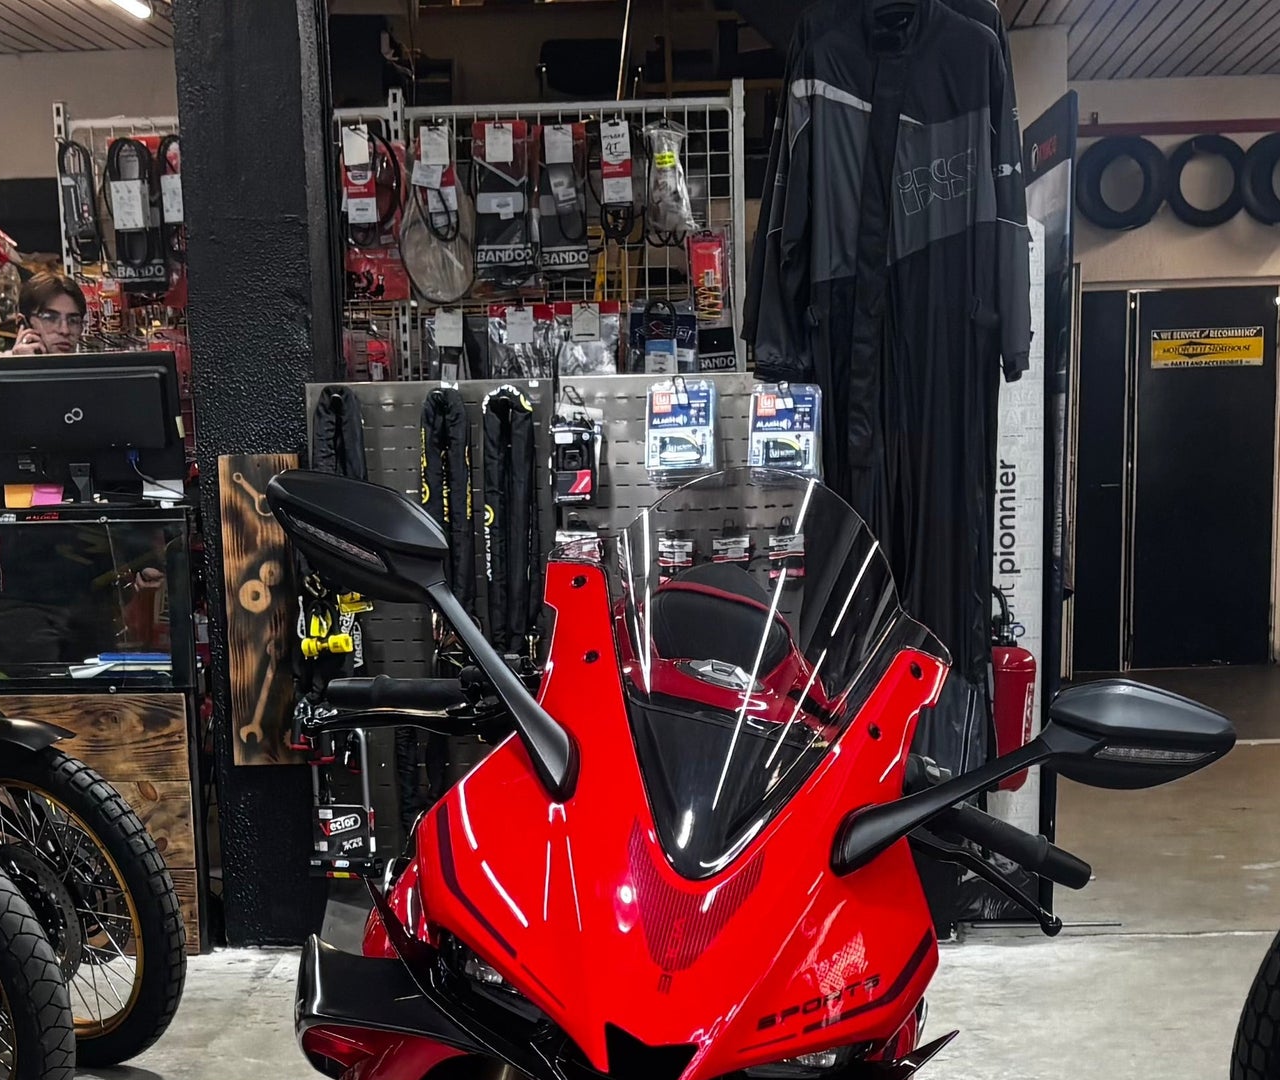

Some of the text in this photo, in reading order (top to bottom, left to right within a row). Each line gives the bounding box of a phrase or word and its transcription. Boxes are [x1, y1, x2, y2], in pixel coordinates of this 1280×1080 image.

[117, 265, 166, 278] BANDO
[997, 457, 1022, 575] pionnier
[320, 814, 357, 837] Vector
[756, 974, 881, 1032] SPORTS
